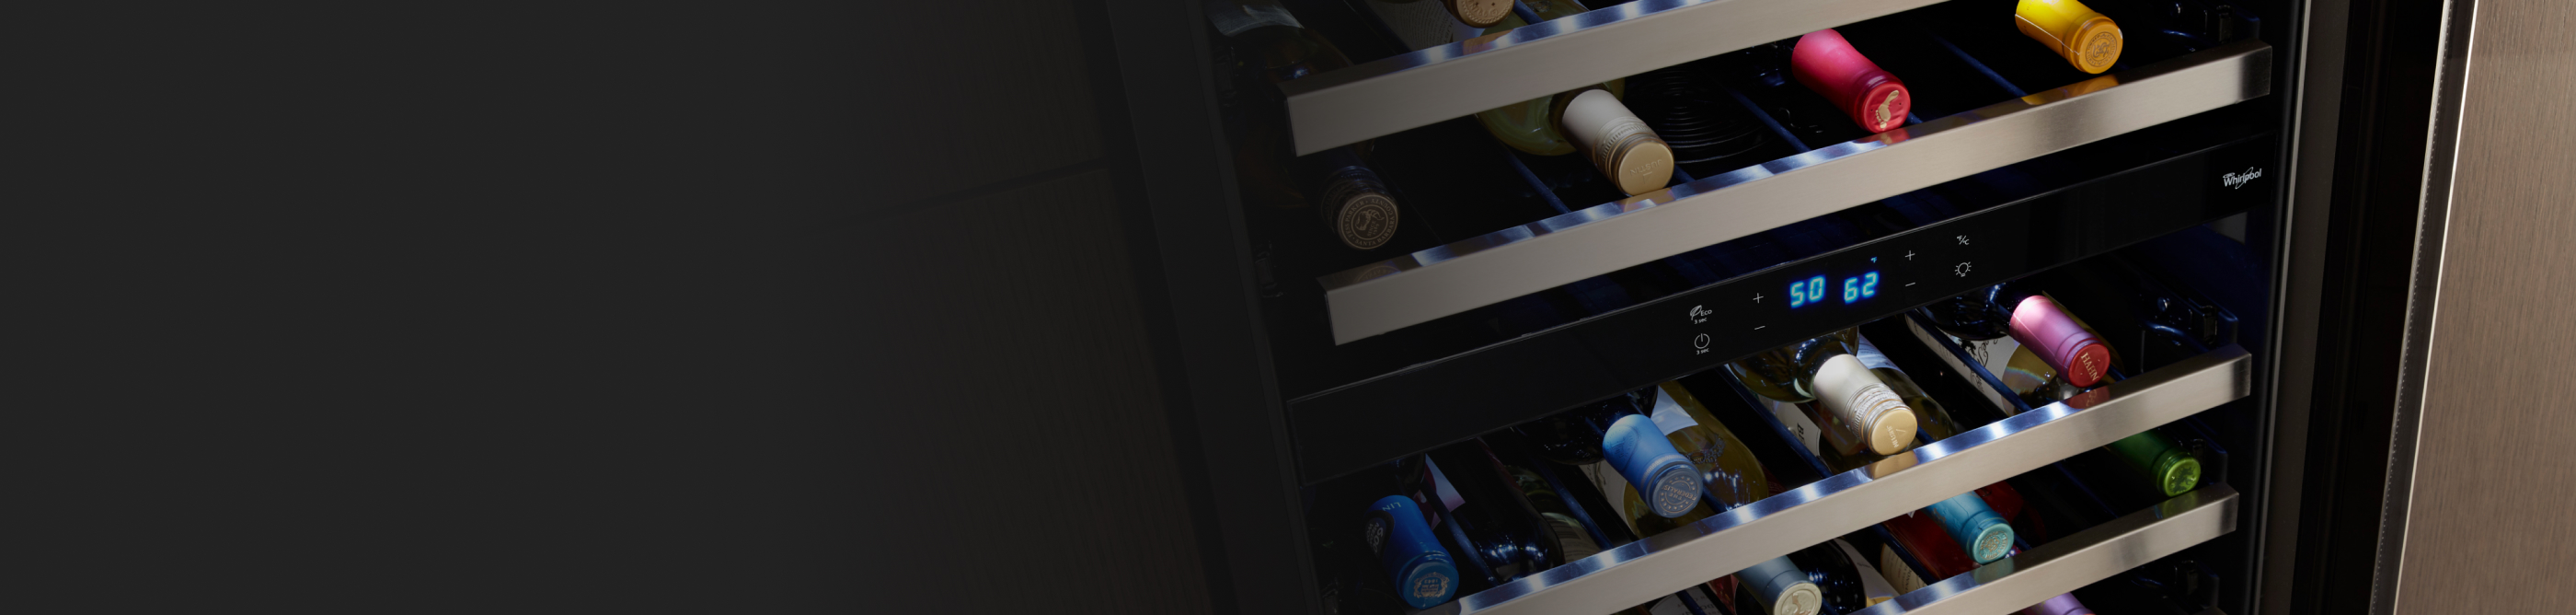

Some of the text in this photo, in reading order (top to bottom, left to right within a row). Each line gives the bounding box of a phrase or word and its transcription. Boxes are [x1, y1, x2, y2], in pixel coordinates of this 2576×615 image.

[1629, 158, 1662, 176] JUSTIN
[2223, 167, 2262, 189] Whirlpool
[1344, 200, 1365, 238] FESS PARKER
[1354, 198, 1396, 247] SANTA BARBARA COUNTY
[1790, 272, 1880, 308] 50 62
[2080, 352, 2100, 381] HAHN
